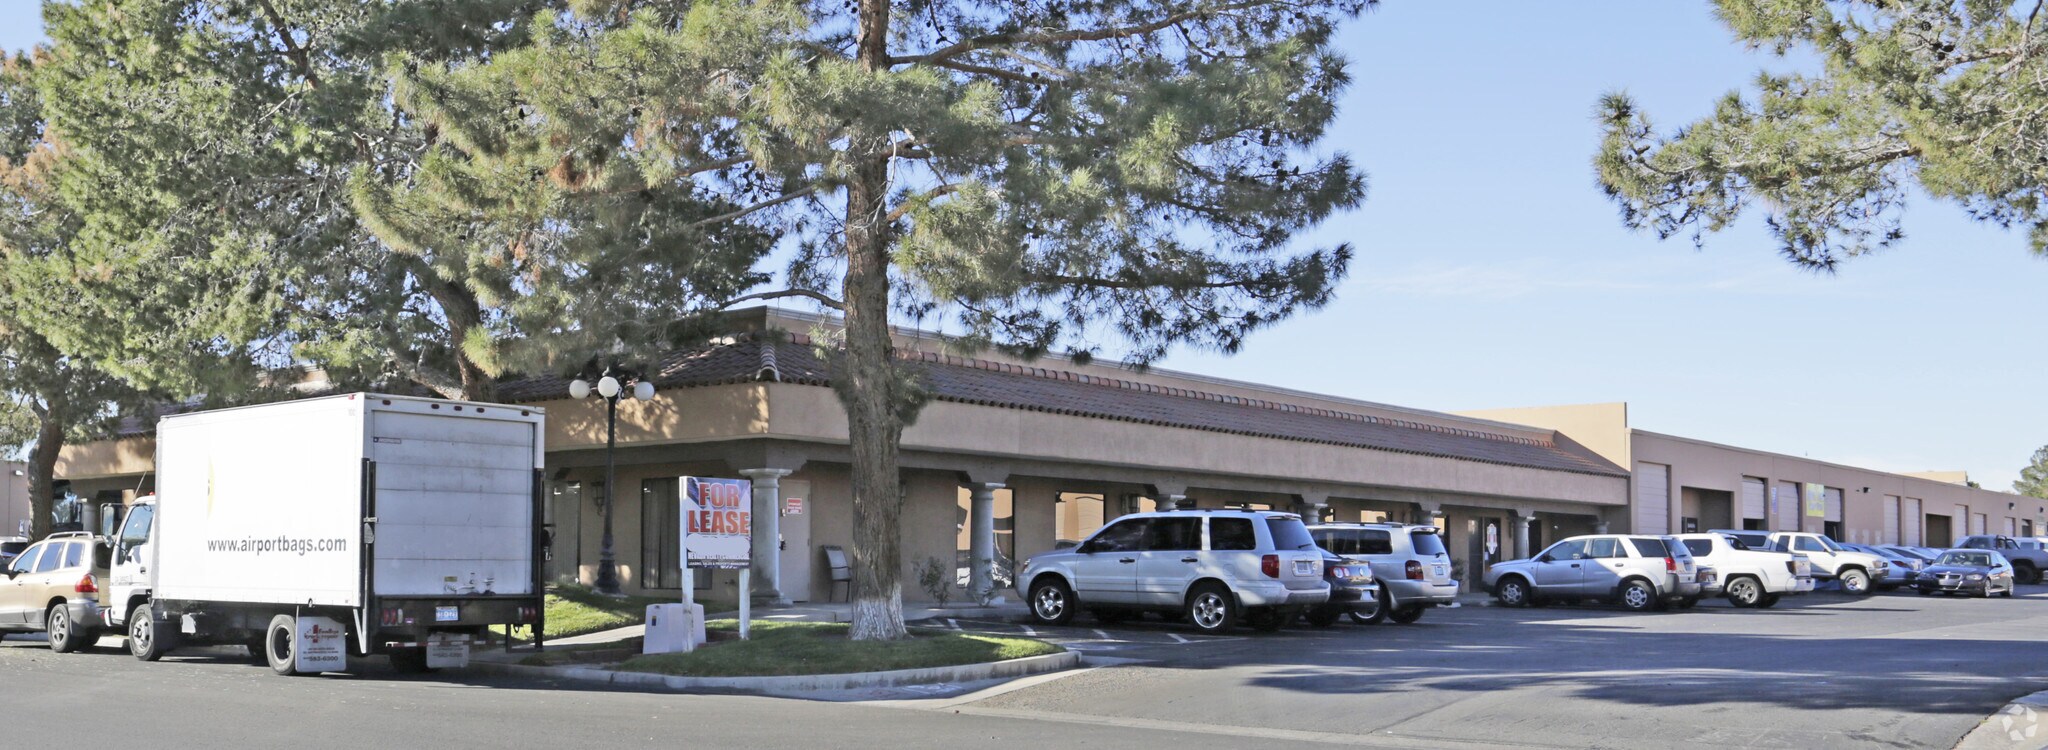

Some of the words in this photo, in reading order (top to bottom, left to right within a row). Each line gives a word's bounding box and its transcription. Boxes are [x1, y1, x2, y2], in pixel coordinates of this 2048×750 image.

[699, 483, 740, 508] FOR
[688, 510, 750, 534] LEASE
[207, 535, 347, 556] www.airportbags.com
